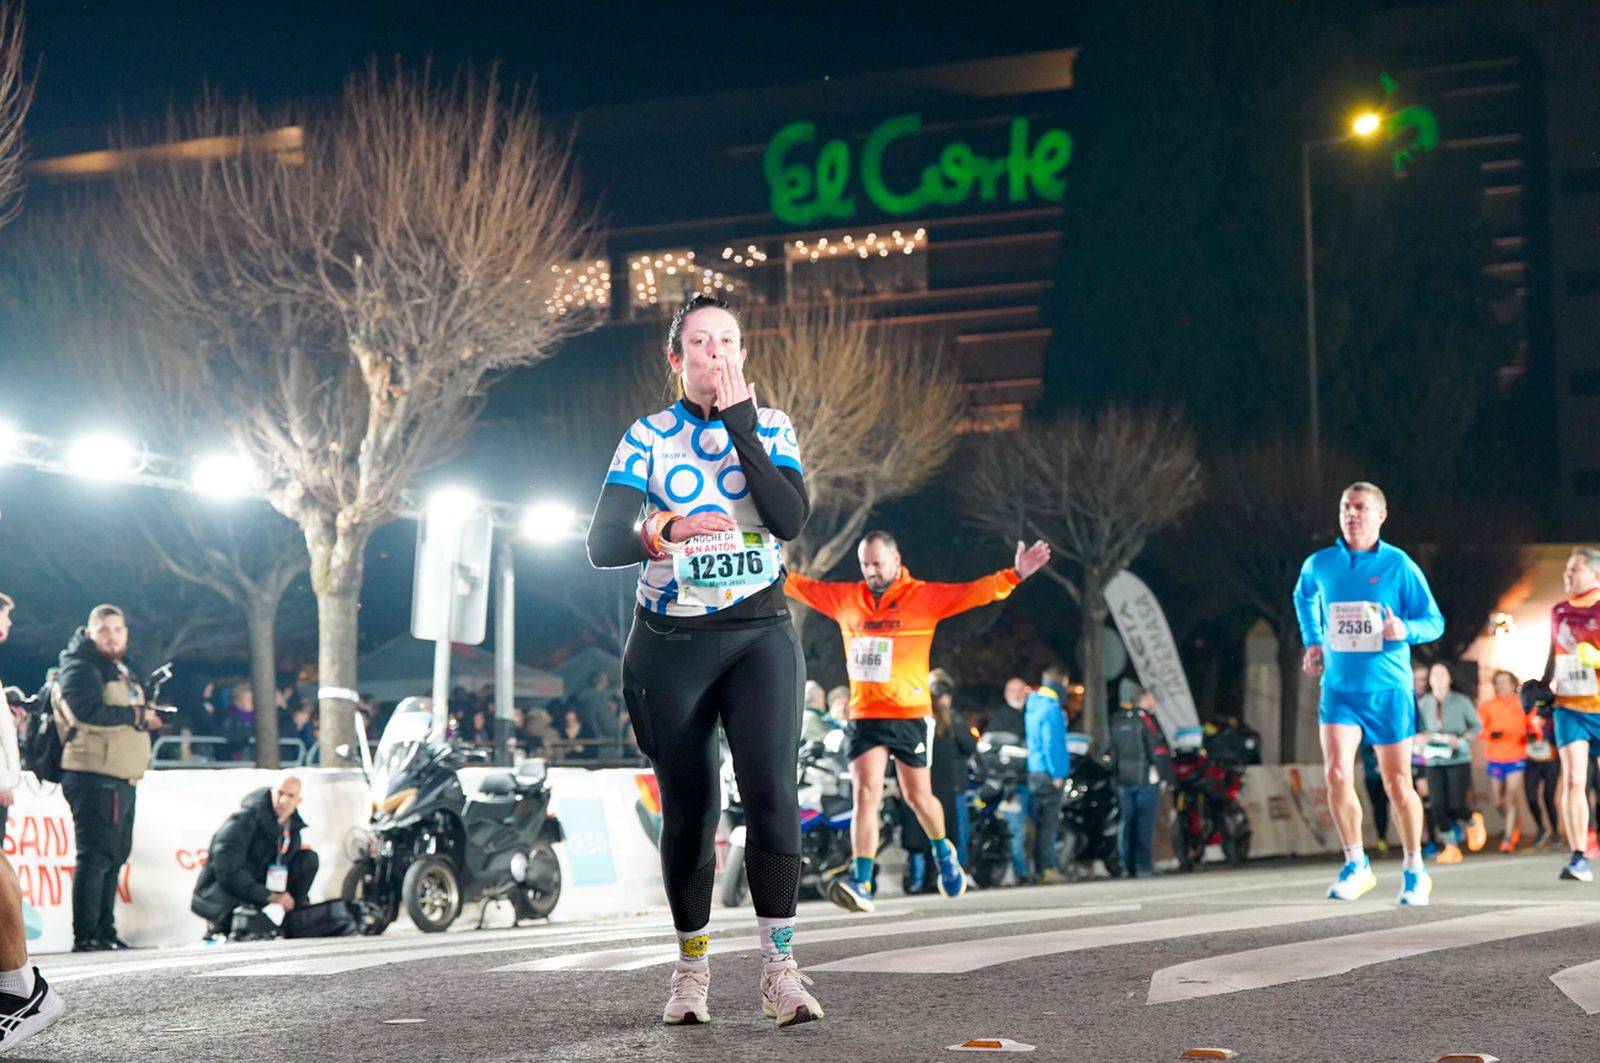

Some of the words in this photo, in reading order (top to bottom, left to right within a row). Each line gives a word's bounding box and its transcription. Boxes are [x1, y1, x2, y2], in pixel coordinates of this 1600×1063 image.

[763, 121, 855, 223] El
[860, 114, 1073, 214] Corte
[684, 545, 703, 557] SAN
[688, 550, 764, 580] 12376
[1337, 620, 1373, 635] 2536
[2, 816, 68, 857] SAN
